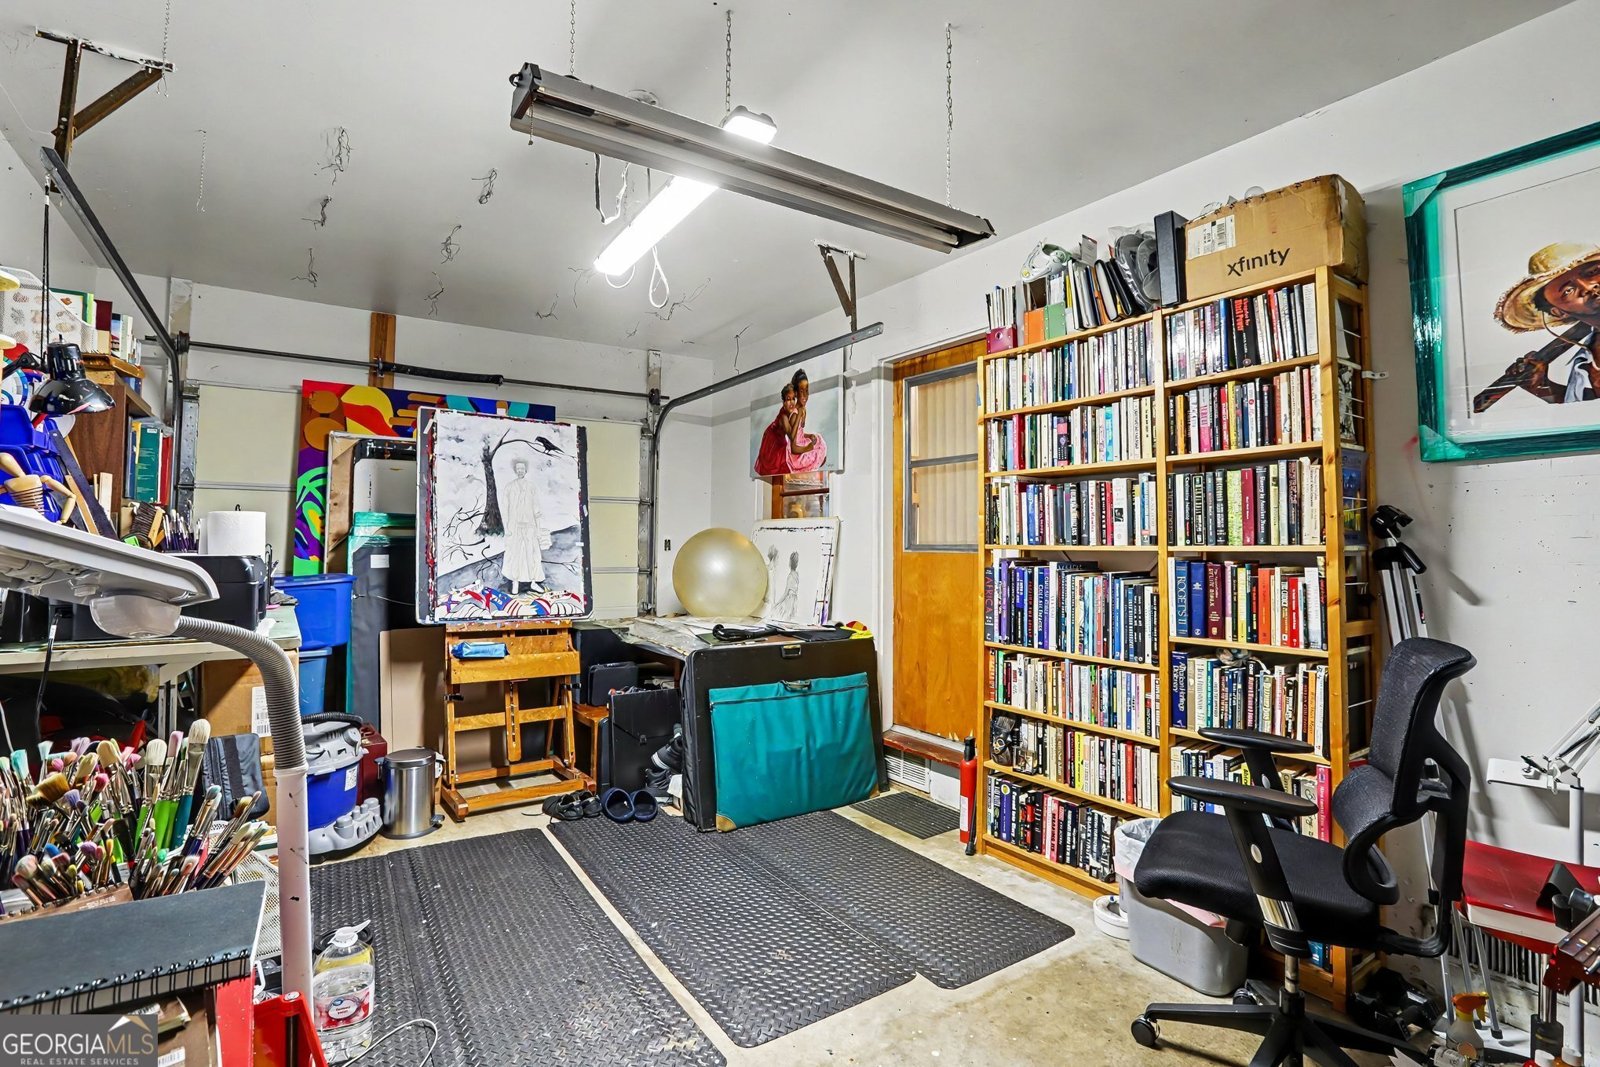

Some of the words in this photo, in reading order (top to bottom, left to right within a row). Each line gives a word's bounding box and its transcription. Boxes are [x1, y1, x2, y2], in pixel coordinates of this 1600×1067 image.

[1227, 247, 1291, 277] xfinity
[985, 577, 993, 614] AFRICA
[1176, 576, 1187, 616] ROGET'S
